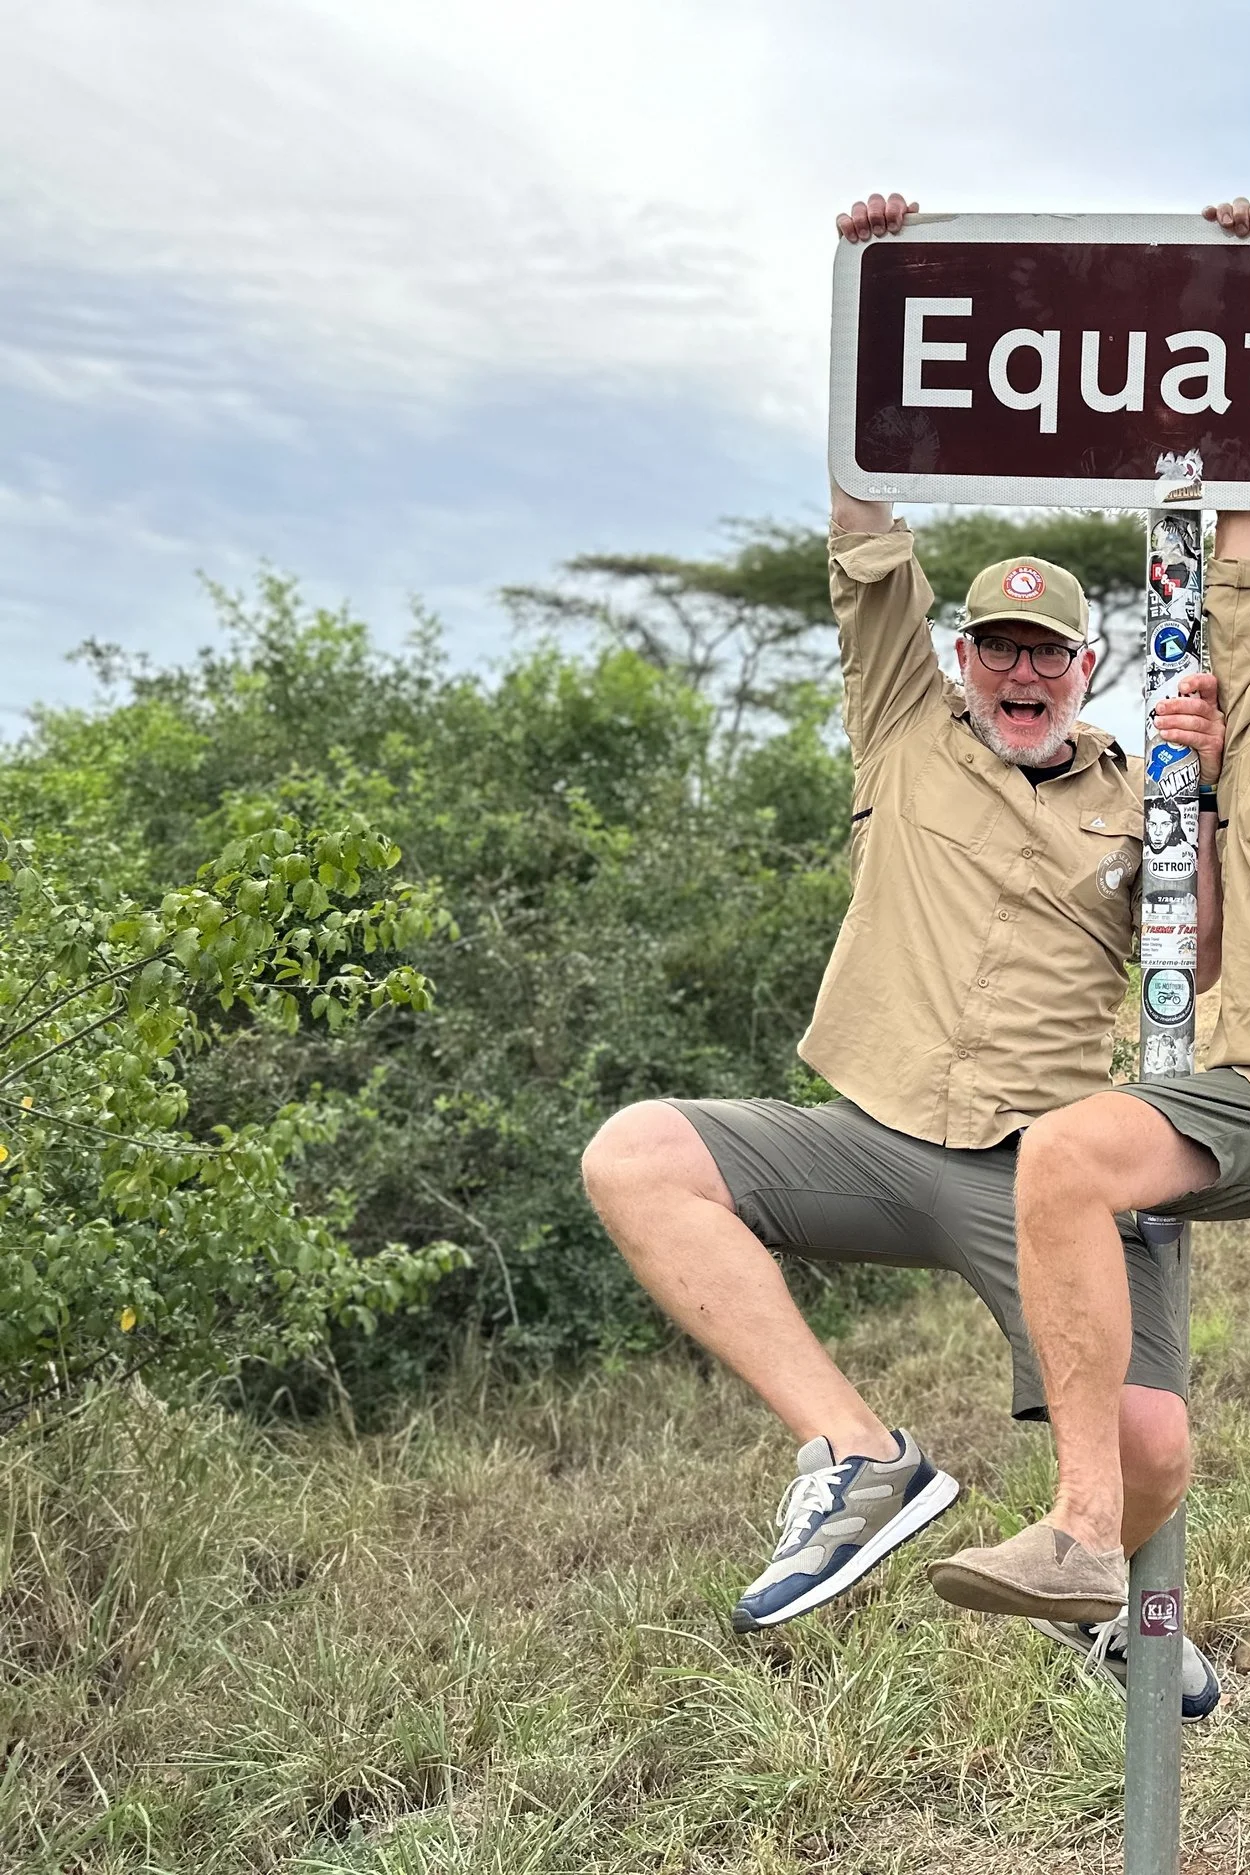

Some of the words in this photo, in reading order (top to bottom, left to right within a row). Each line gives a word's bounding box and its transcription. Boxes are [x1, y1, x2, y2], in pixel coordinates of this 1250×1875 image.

[1104, 853, 1118, 867] THE
[1152, 862, 1192, 872] DETROIT
[1148, 1603, 1173, 1616] K1.2
